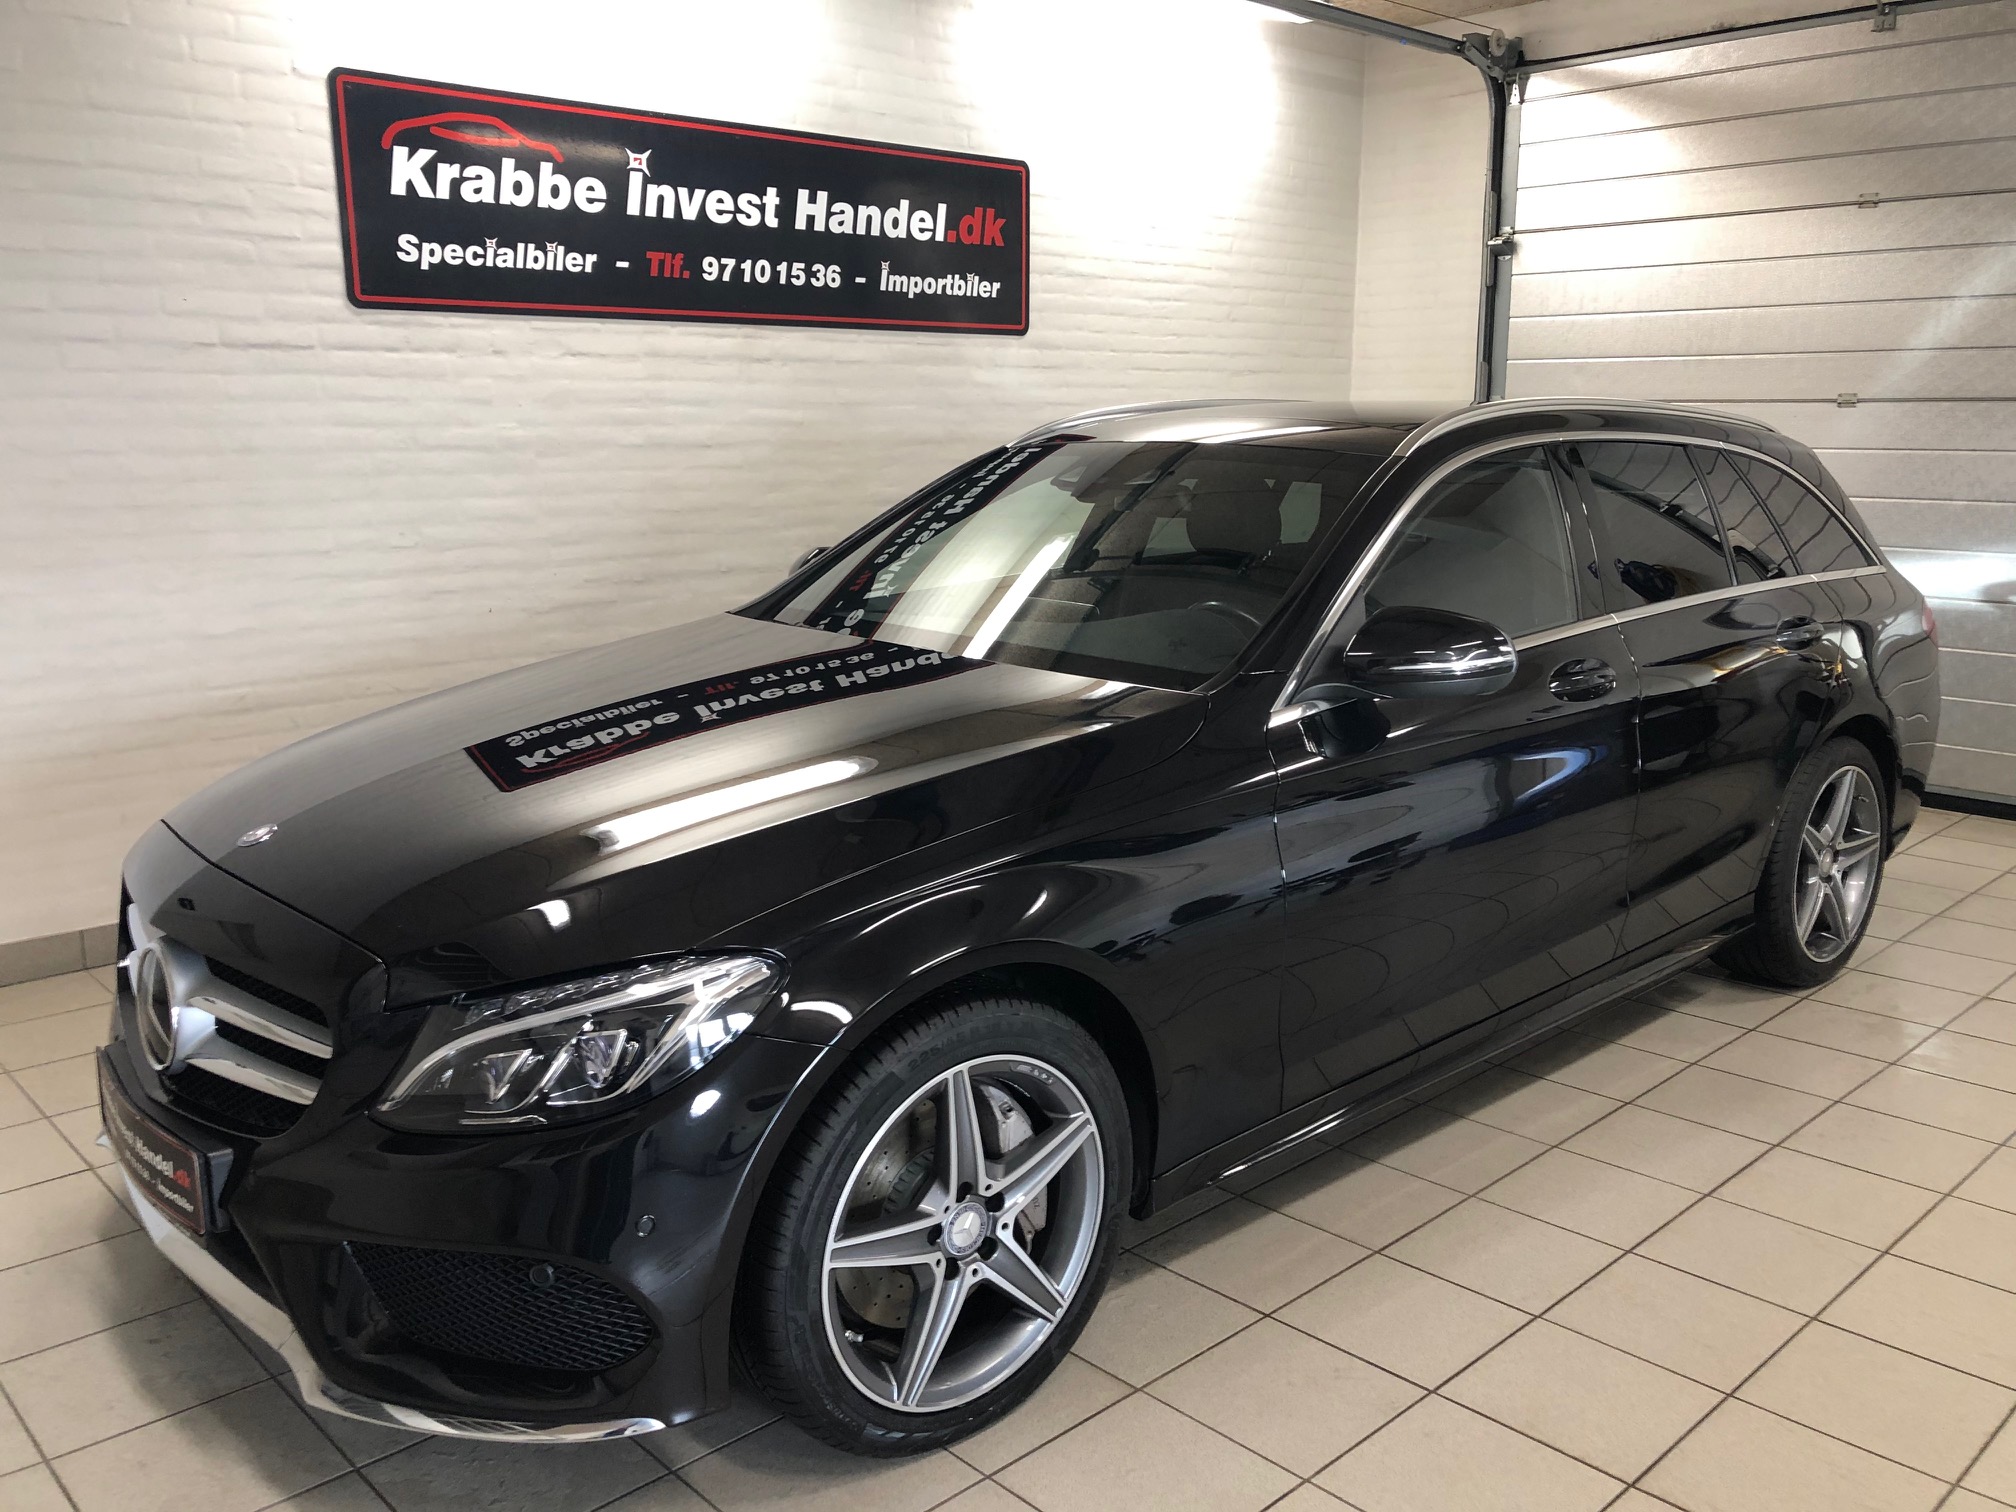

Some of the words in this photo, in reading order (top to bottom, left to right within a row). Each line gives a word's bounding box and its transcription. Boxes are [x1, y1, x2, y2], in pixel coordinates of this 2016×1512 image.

[390, 145, 607, 213] Krabbe
[795, 188, 1007, 247] Handel.dk
[396, 233, 598, 273] Specialbiler
[646, 251, 691, 279] Tlf.
